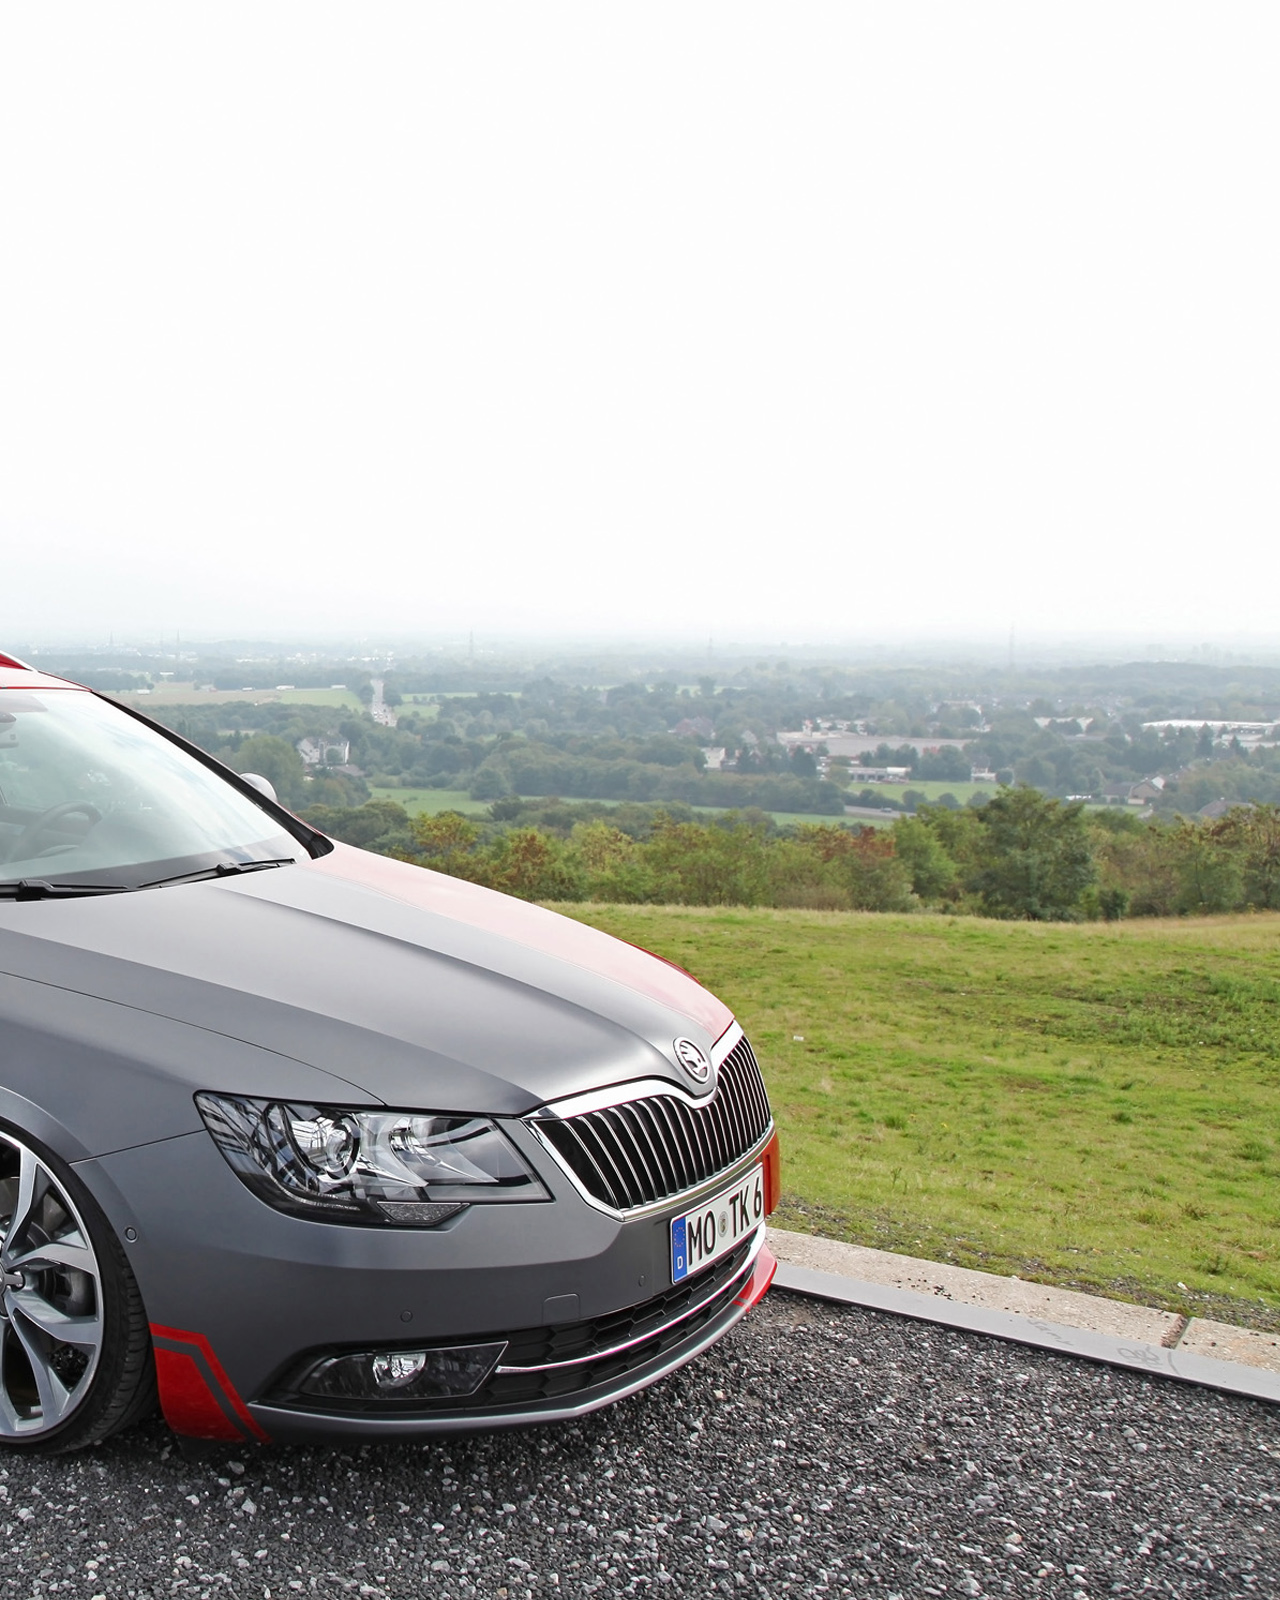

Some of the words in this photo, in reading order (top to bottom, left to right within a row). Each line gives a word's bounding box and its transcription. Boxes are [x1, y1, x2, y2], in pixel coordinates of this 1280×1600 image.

[687, 1210, 716, 1266] MO
[728, 1185, 750, 1238] TK
[754, 1176, 762, 1219] 6
[677, 1255, 684, 1270] D
